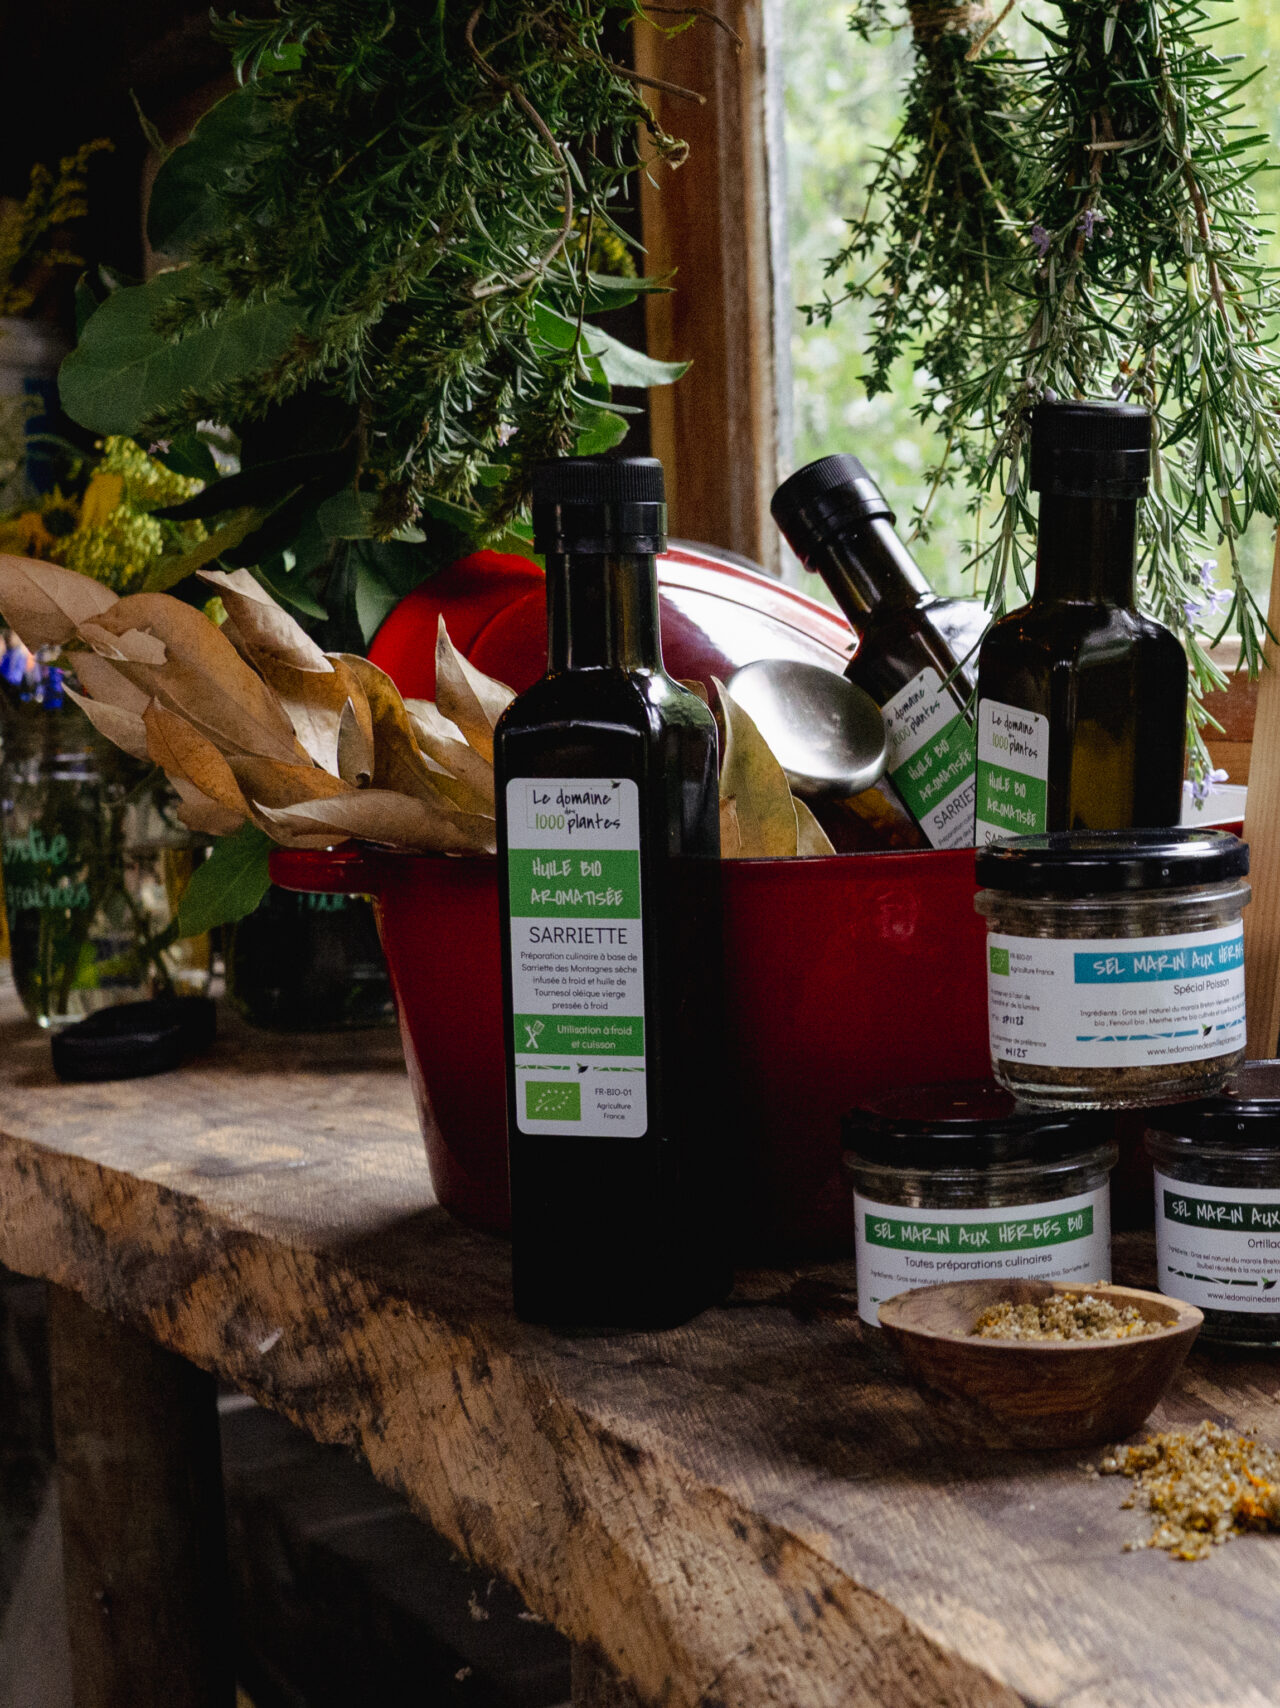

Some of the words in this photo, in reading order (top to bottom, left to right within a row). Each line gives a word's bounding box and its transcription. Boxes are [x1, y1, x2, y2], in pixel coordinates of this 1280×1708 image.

[894, 688, 925, 719] domaine
[910, 700, 941, 735] plantes
[992, 711, 1002, 726] Le
[1004, 713, 1034, 735] domaine
[992, 732, 1008, 751] 1000
[1009, 738, 1038, 759] plantes
[533, 789, 551, 804] Le
[556, 787, 612, 808] domaine
[1014, 781, 1026, 798] BIO
[535, 812, 565, 830] 1000
[567, 812, 621, 835] plantes
[532, 857, 571, 879] HUILE
[580, 860, 602, 877] BIO
[530, 887, 624, 906] AROMATISÉE
[529, 926, 628, 944] SARRIETTE
[520, 951, 564, 962] Préparation
[565, 952, 598, 961] culinaire
[607, 952, 626, 961] base
[627, 953, 638, 961] de
[1093, 956, 1125, 976] SEL
[1133, 952, 1186, 975] MARIN
[1192, 951, 1215, 970] AUX
[521, 963, 554, 972] Sarriette
[555, 964, 569, 973] des
[570, 964, 613, 975] Montagnes
[568, 976, 586, 985] froid
[587, 977, 595, 985] et
[616, 978, 627, 986] de
[1174, 981, 1205, 996] Spécial
[1206, 978, 1230, 990] Poisson
[534, 988, 571, 997] Tournesol
[601, 989, 626, 1000] vierge
[552, 1001, 582, 1010] pressée
[590, 1001, 608, 1010] froid
[1122, 1008, 1137, 1016] Gros
[1138, 1008, 1148, 1016] sel
[557, 1023, 601, 1035] Utilisation
[603, 1024, 610, 1035] à
[610, 1024, 632, 1036] froid
[571, 1040, 581, 1048] et
[582, 1040, 616, 1049] cuisson
[594, 1087, 632, 1097] FR-BIO-01
[597, 1102, 631, 1111] Agriculture
[603, 1112, 625, 1120] France
[1172, 1200, 1191, 1218] SEL
[1196, 1204, 1244, 1224] MARIN
[873, 1222, 895, 1240] SEL
[901, 1225, 951, 1244] MARIN
[958, 1227, 991, 1247] AUX
[998, 1220, 1063, 1244] HERBES
[1067, 1213, 1084, 1233] BIO
[904, 1256, 934, 1269] Toutes
[936, 1259, 1003, 1272] préparations
[1005, 1254, 1053, 1268] culinaires
